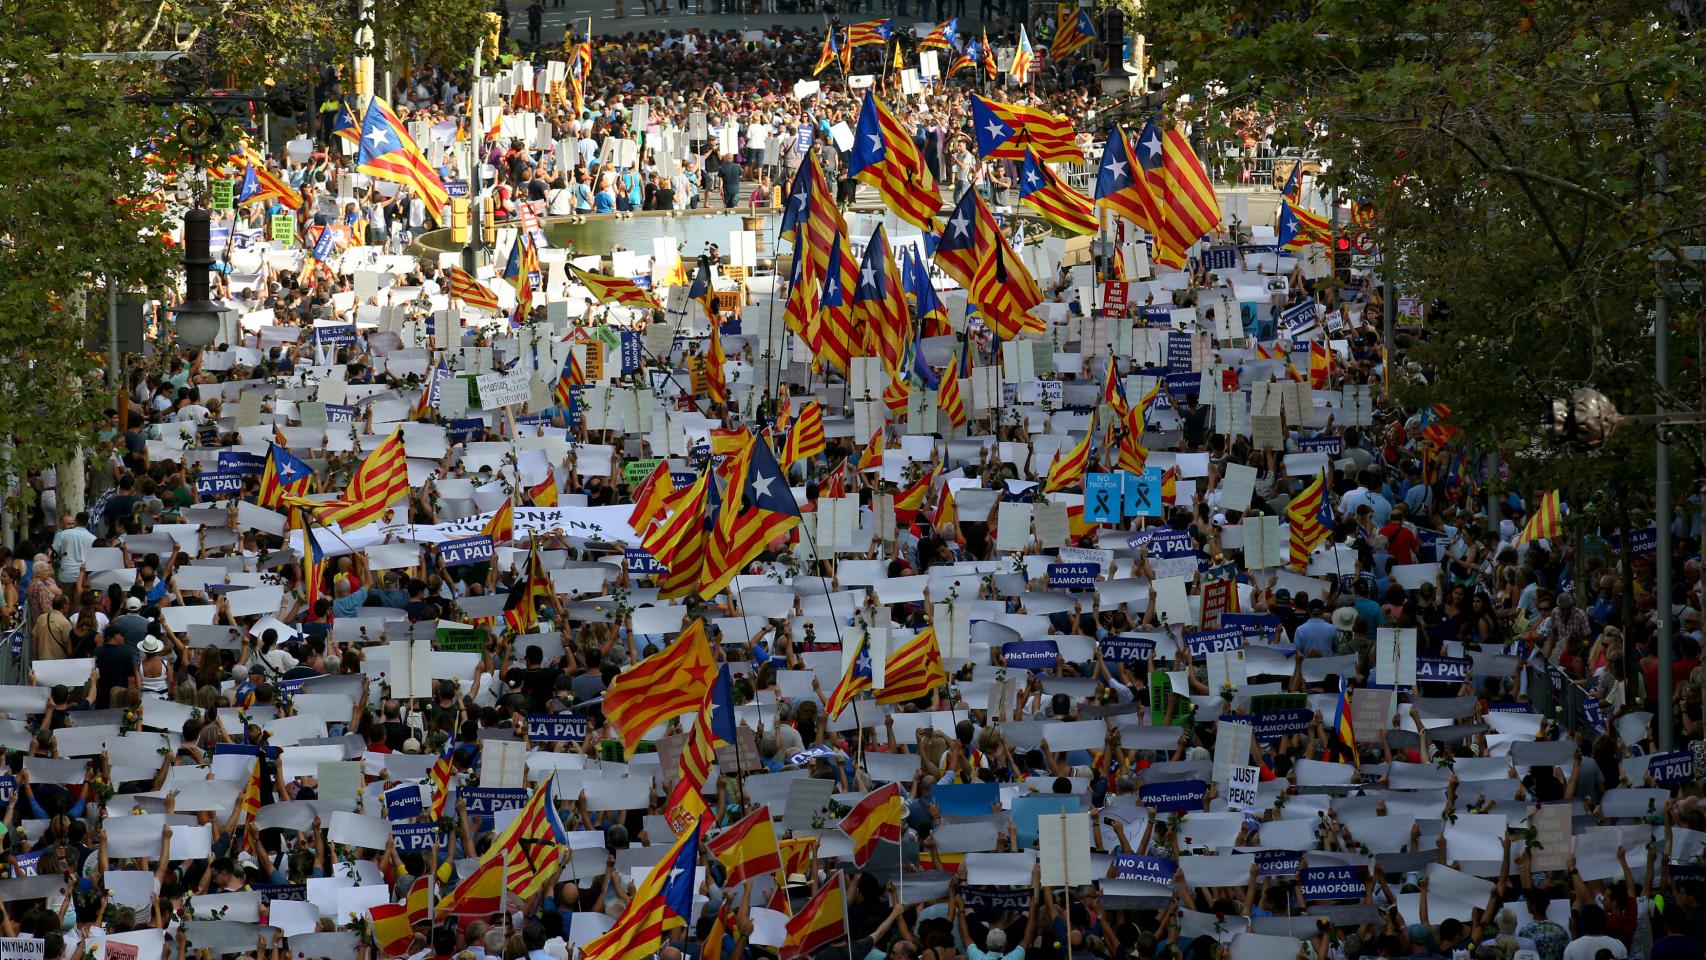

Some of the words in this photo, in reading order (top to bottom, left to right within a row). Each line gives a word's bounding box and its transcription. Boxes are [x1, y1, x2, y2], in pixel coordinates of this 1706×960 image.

[1298, 307, 1316, 321] PAU
[1317, 445, 1339, 454] PAU
[196, 481, 211, 492] LA
[216, 479, 242, 490] PAU
[1166, 541, 1194, 551] PAU
[1632, 542, 1656, 552] OFÒBI
[441, 551, 460, 563] LA
[464, 545, 493, 560] PAU
[627, 559, 646, 570] LA
[649, 559, 668, 570] PA
[1050, 576, 1095, 584] SLAMOFÒBI
[1217, 630, 1242, 638] RESPOSTA
[1120, 648, 1150, 660] PAU
[1189, 642, 1209, 656] LA
[1005, 651, 1058, 660] #NoTenimPor
[528, 724, 548, 736] LA
[554, 724, 587, 737] PAU
[1254, 721, 1309, 732] SLAMOFÒBIA
[1670, 755, 1692, 764] RESPOSTA
[1233, 768, 1255, 784] JUST
[1666, 762, 1692, 779] PAU
[390, 797, 420, 807] nimPor
[1142, 793, 1203, 803] #NoTenimPor
[411, 834, 448, 850] PAU
[18, 856, 40, 866] RESPOS
[1119, 859, 1135, 868] NO
[1138, 861, 1144, 869] A
[1148, 862, 1159, 871] LA
[1257, 860, 1299, 870] MOFÒBIA
[1116, 872, 1172, 884] AMOFÒBIA
[1308, 872, 1325, 880] NO
[1338, 871, 1350, 879] LA
[1300, 882, 1366, 895] SLAMOFÒBIA
[961, 894, 985, 906] LA
[992, 896, 1031, 908] PAU
[2, 942, 9, 952] NI
[12, 942, 34, 953] YIHAD
[36, 943, 43, 954] NI
